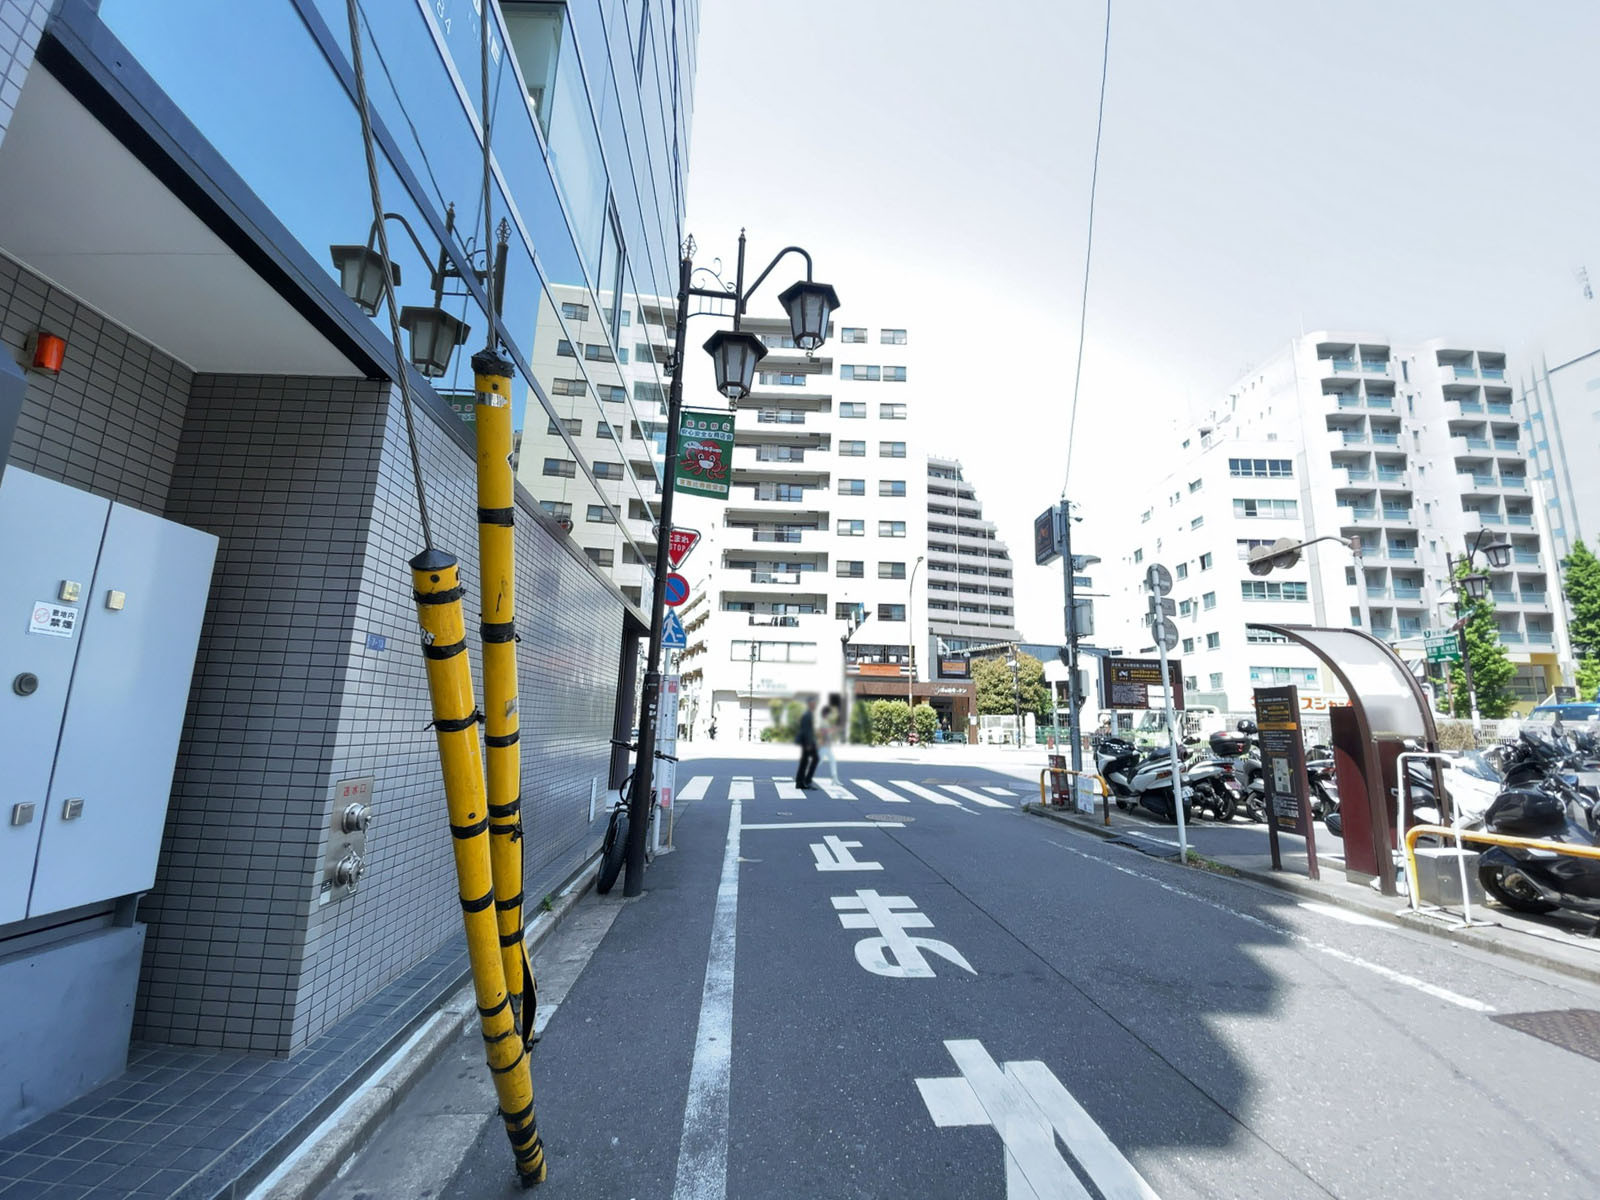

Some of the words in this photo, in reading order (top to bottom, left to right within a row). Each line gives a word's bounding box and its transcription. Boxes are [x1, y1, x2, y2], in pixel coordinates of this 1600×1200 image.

[49, 617, 74, 630] 禁煙
[343, 783, 367, 797] 送水口
